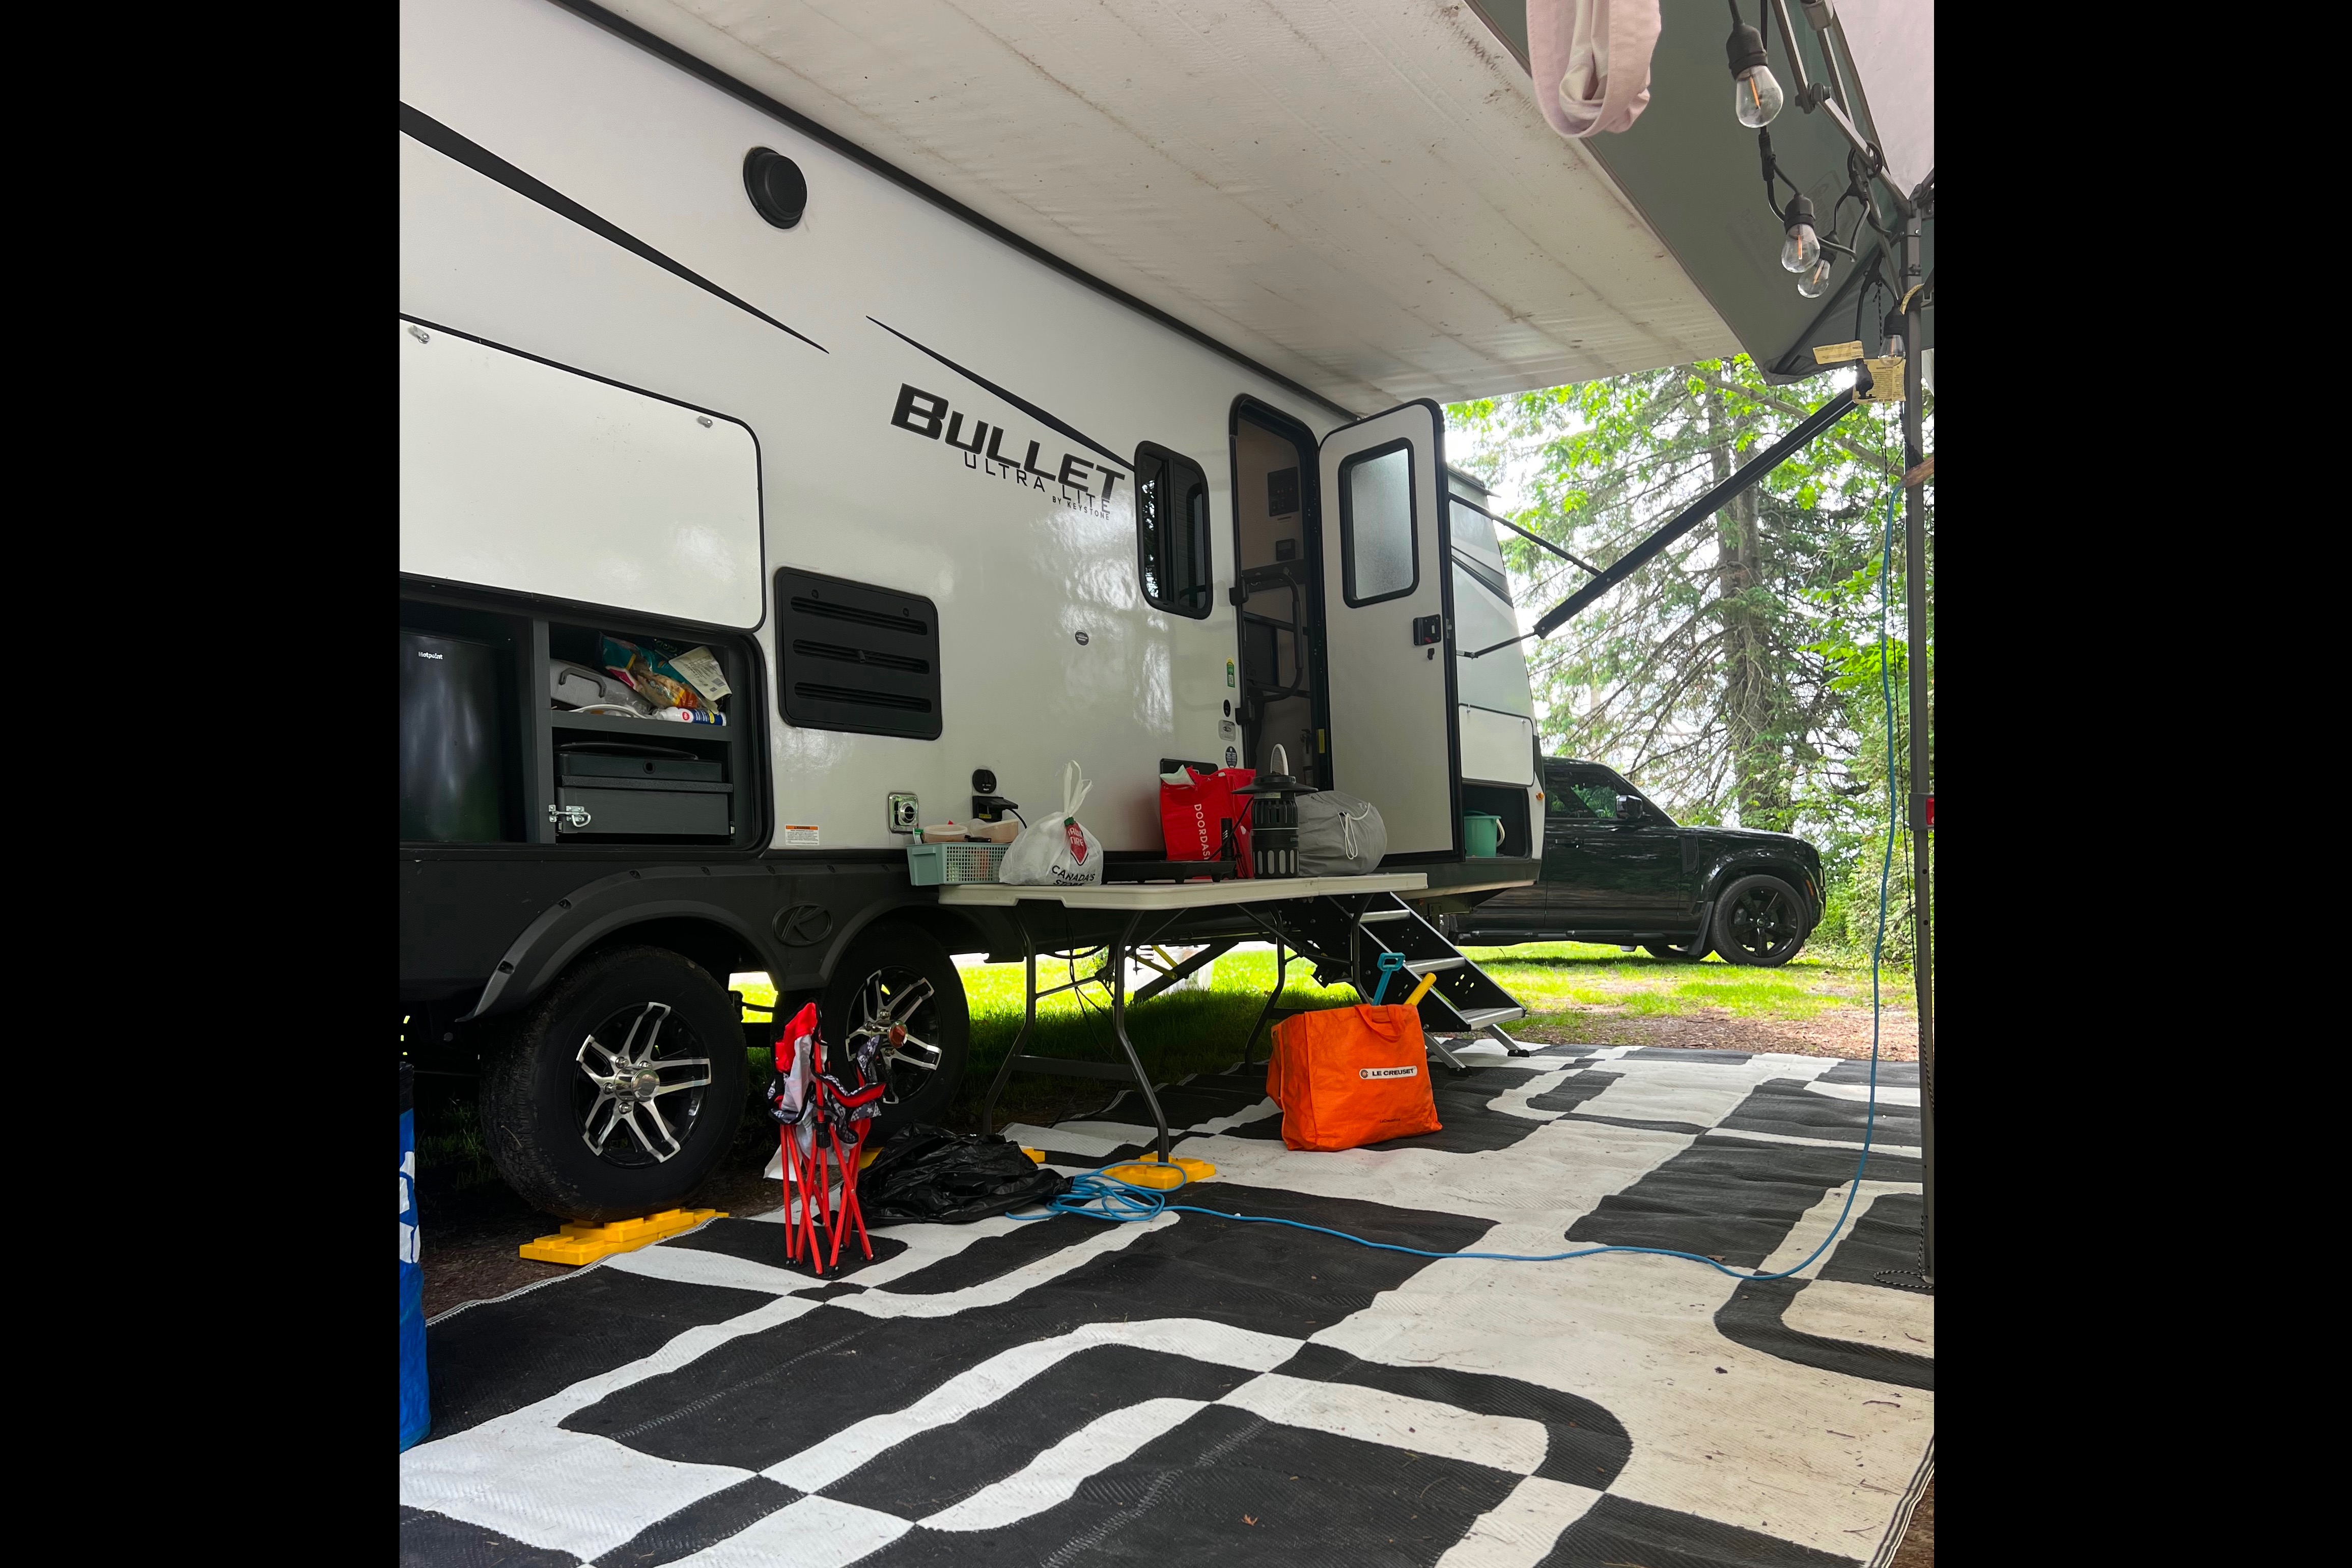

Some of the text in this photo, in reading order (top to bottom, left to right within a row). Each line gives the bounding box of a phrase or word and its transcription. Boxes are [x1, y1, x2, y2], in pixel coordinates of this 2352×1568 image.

[891, 383, 1125, 500] BULLET
[964, 451, 1110, 514] ULTRA LITE
[1052, 496, 1109, 520] BY KEYSTONE
[1051, 865, 1096, 881] CANADA'S
[1383, 1068, 1414, 1076] CREUSET
